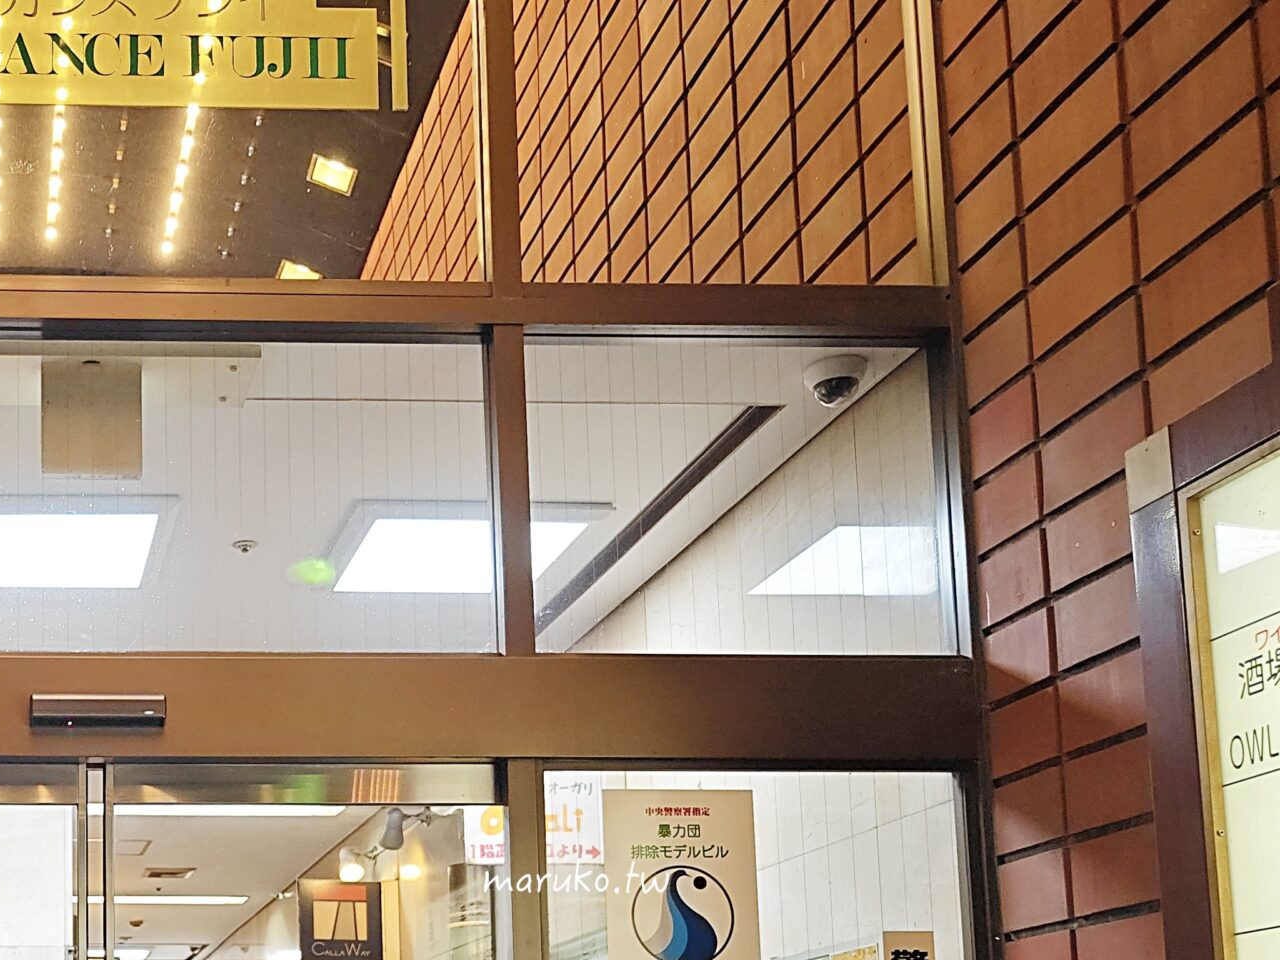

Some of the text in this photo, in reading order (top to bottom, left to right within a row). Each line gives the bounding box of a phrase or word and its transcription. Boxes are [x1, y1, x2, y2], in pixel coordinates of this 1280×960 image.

[181, 34, 357, 80] FUJII
[645, 806, 711, 817] 中央警察署指定
[657, 823, 701, 839] 暴力団
[630, 844, 729, 860] 排除モデルビル
